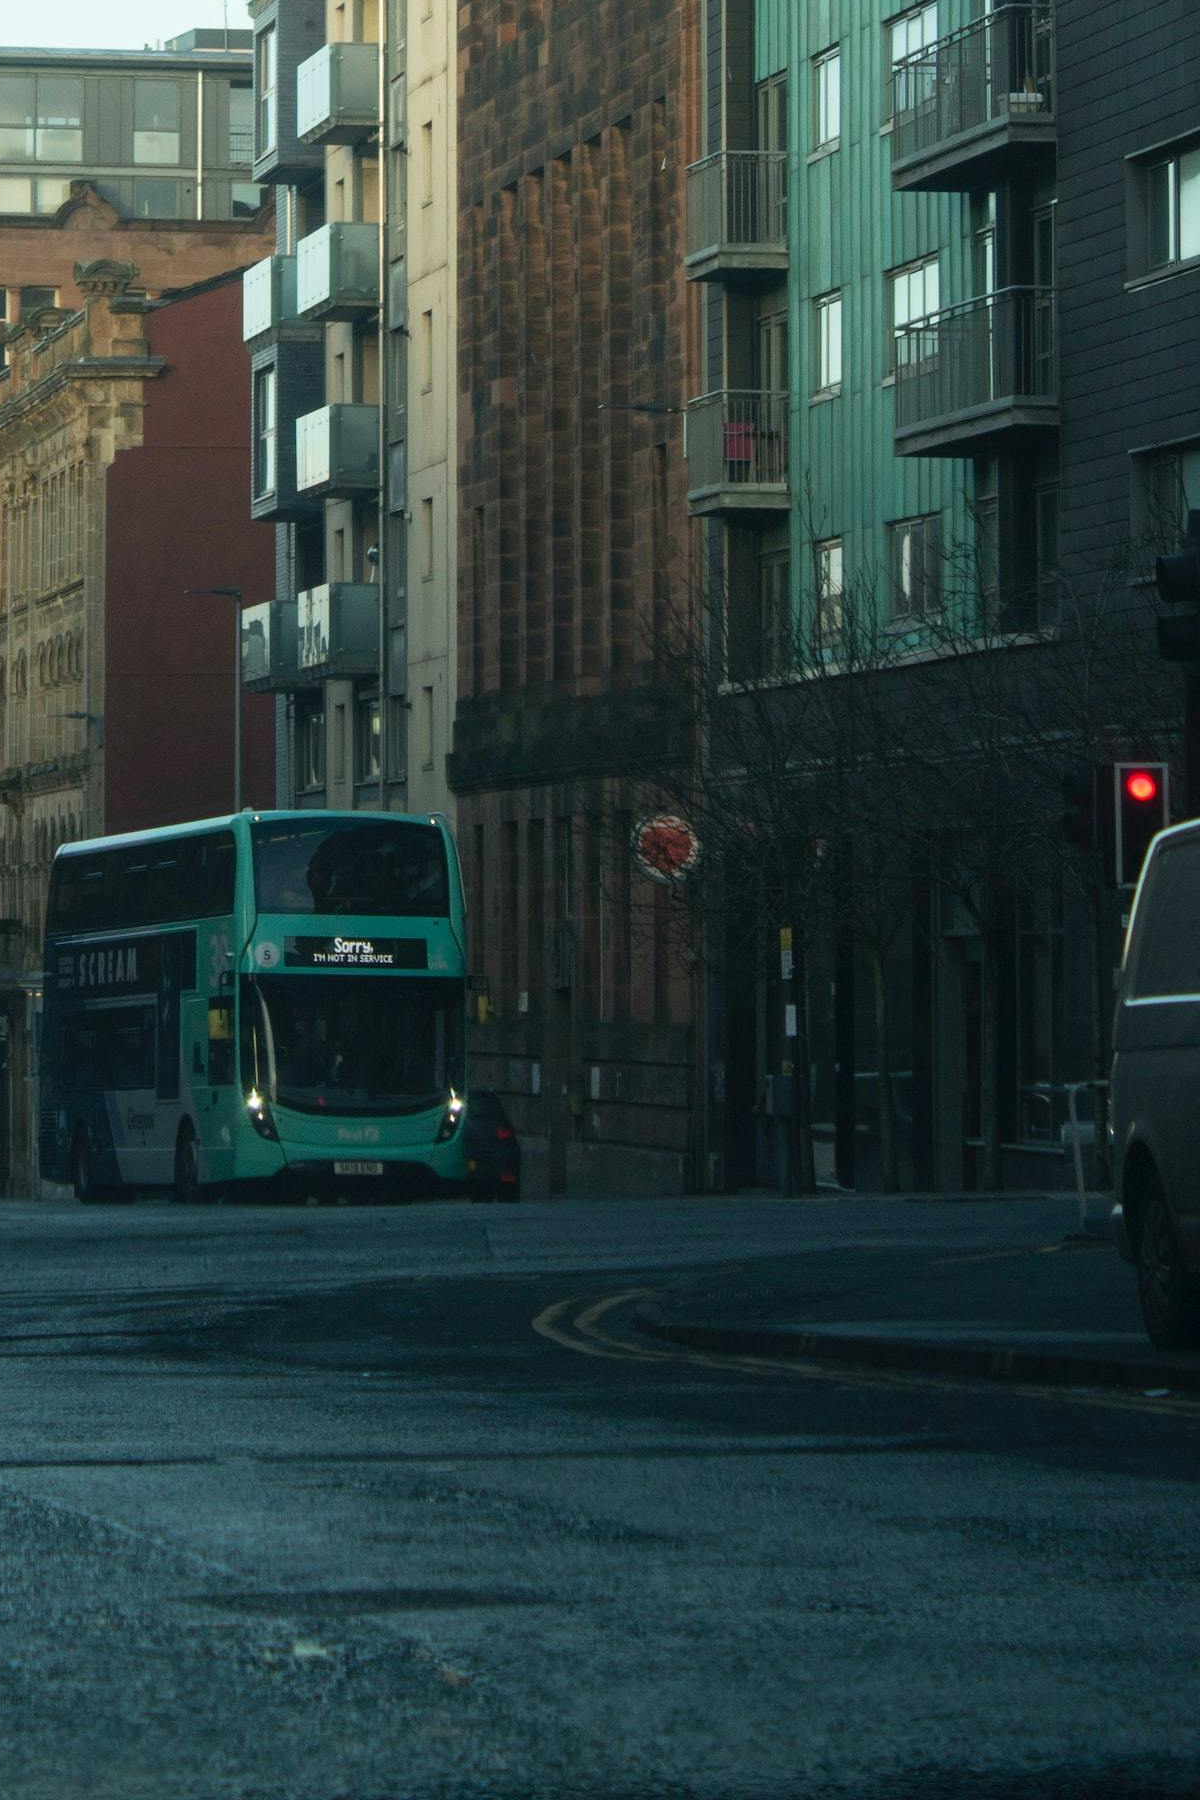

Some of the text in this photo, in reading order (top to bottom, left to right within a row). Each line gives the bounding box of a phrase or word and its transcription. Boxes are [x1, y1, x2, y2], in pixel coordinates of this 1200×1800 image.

[334, 937, 374, 953] Sorry,
[313, 953, 393, 964] I'M NOT IN SERVICE
[79, 948, 137, 987] SCREAM
